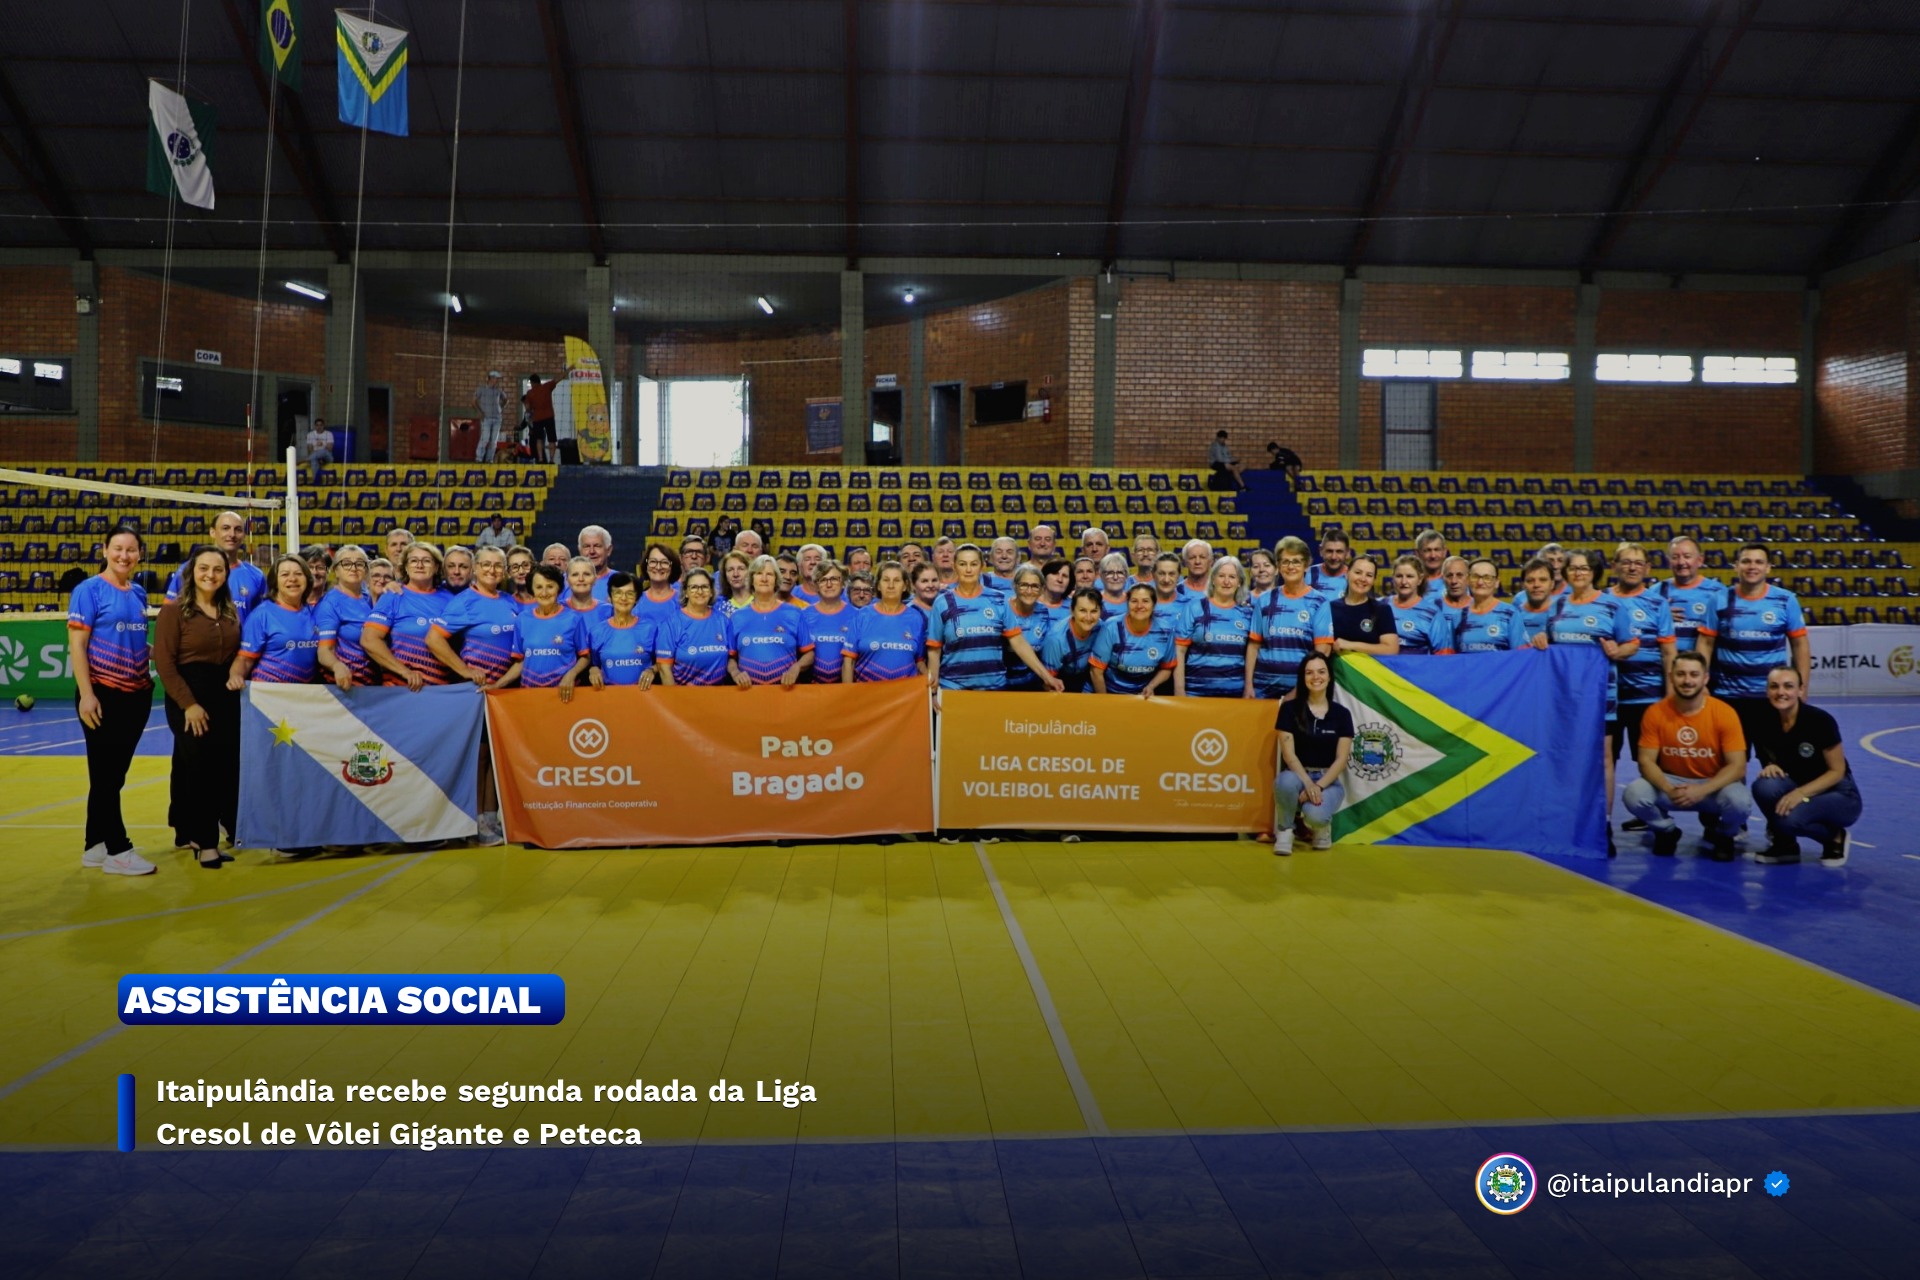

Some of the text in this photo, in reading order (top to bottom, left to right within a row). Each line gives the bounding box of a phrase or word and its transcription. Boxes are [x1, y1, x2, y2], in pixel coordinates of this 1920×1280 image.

[196, 352, 220, 362] COPA
[966, 626, 996, 635] CRESOL
[1277, 626, 1306, 638] CRESOL
[751, 636, 784, 645] CRESOL
[1215, 634, 1245, 643] CRESOL
[1559, 632, 1593, 642] CRESOL
[532, 648, 562, 657] CRESOL
[881, 642, 914, 652] CRESOL
[614, 658, 643, 667] CRESOL
[1821, 654, 1881, 670] METAL
[1004, 718, 1096, 738] Itaipulândia
[760, 735, 834, 758] Pato
[1662, 745, 1716, 758] CRESOL
[979, 755, 1125, 774] LIGA CRESOL DE
[537, 765, 641, 787] CRESOL
[731, 766, 864, 800] Bragado
[1159, 771, 1255, 794] CRESOL
[962, 781, 1140, 800] VOLEIBOL GIGANTE
[565, 800, 607, 809] Financeira
[608, 799, 658, 810] Cooperativa
